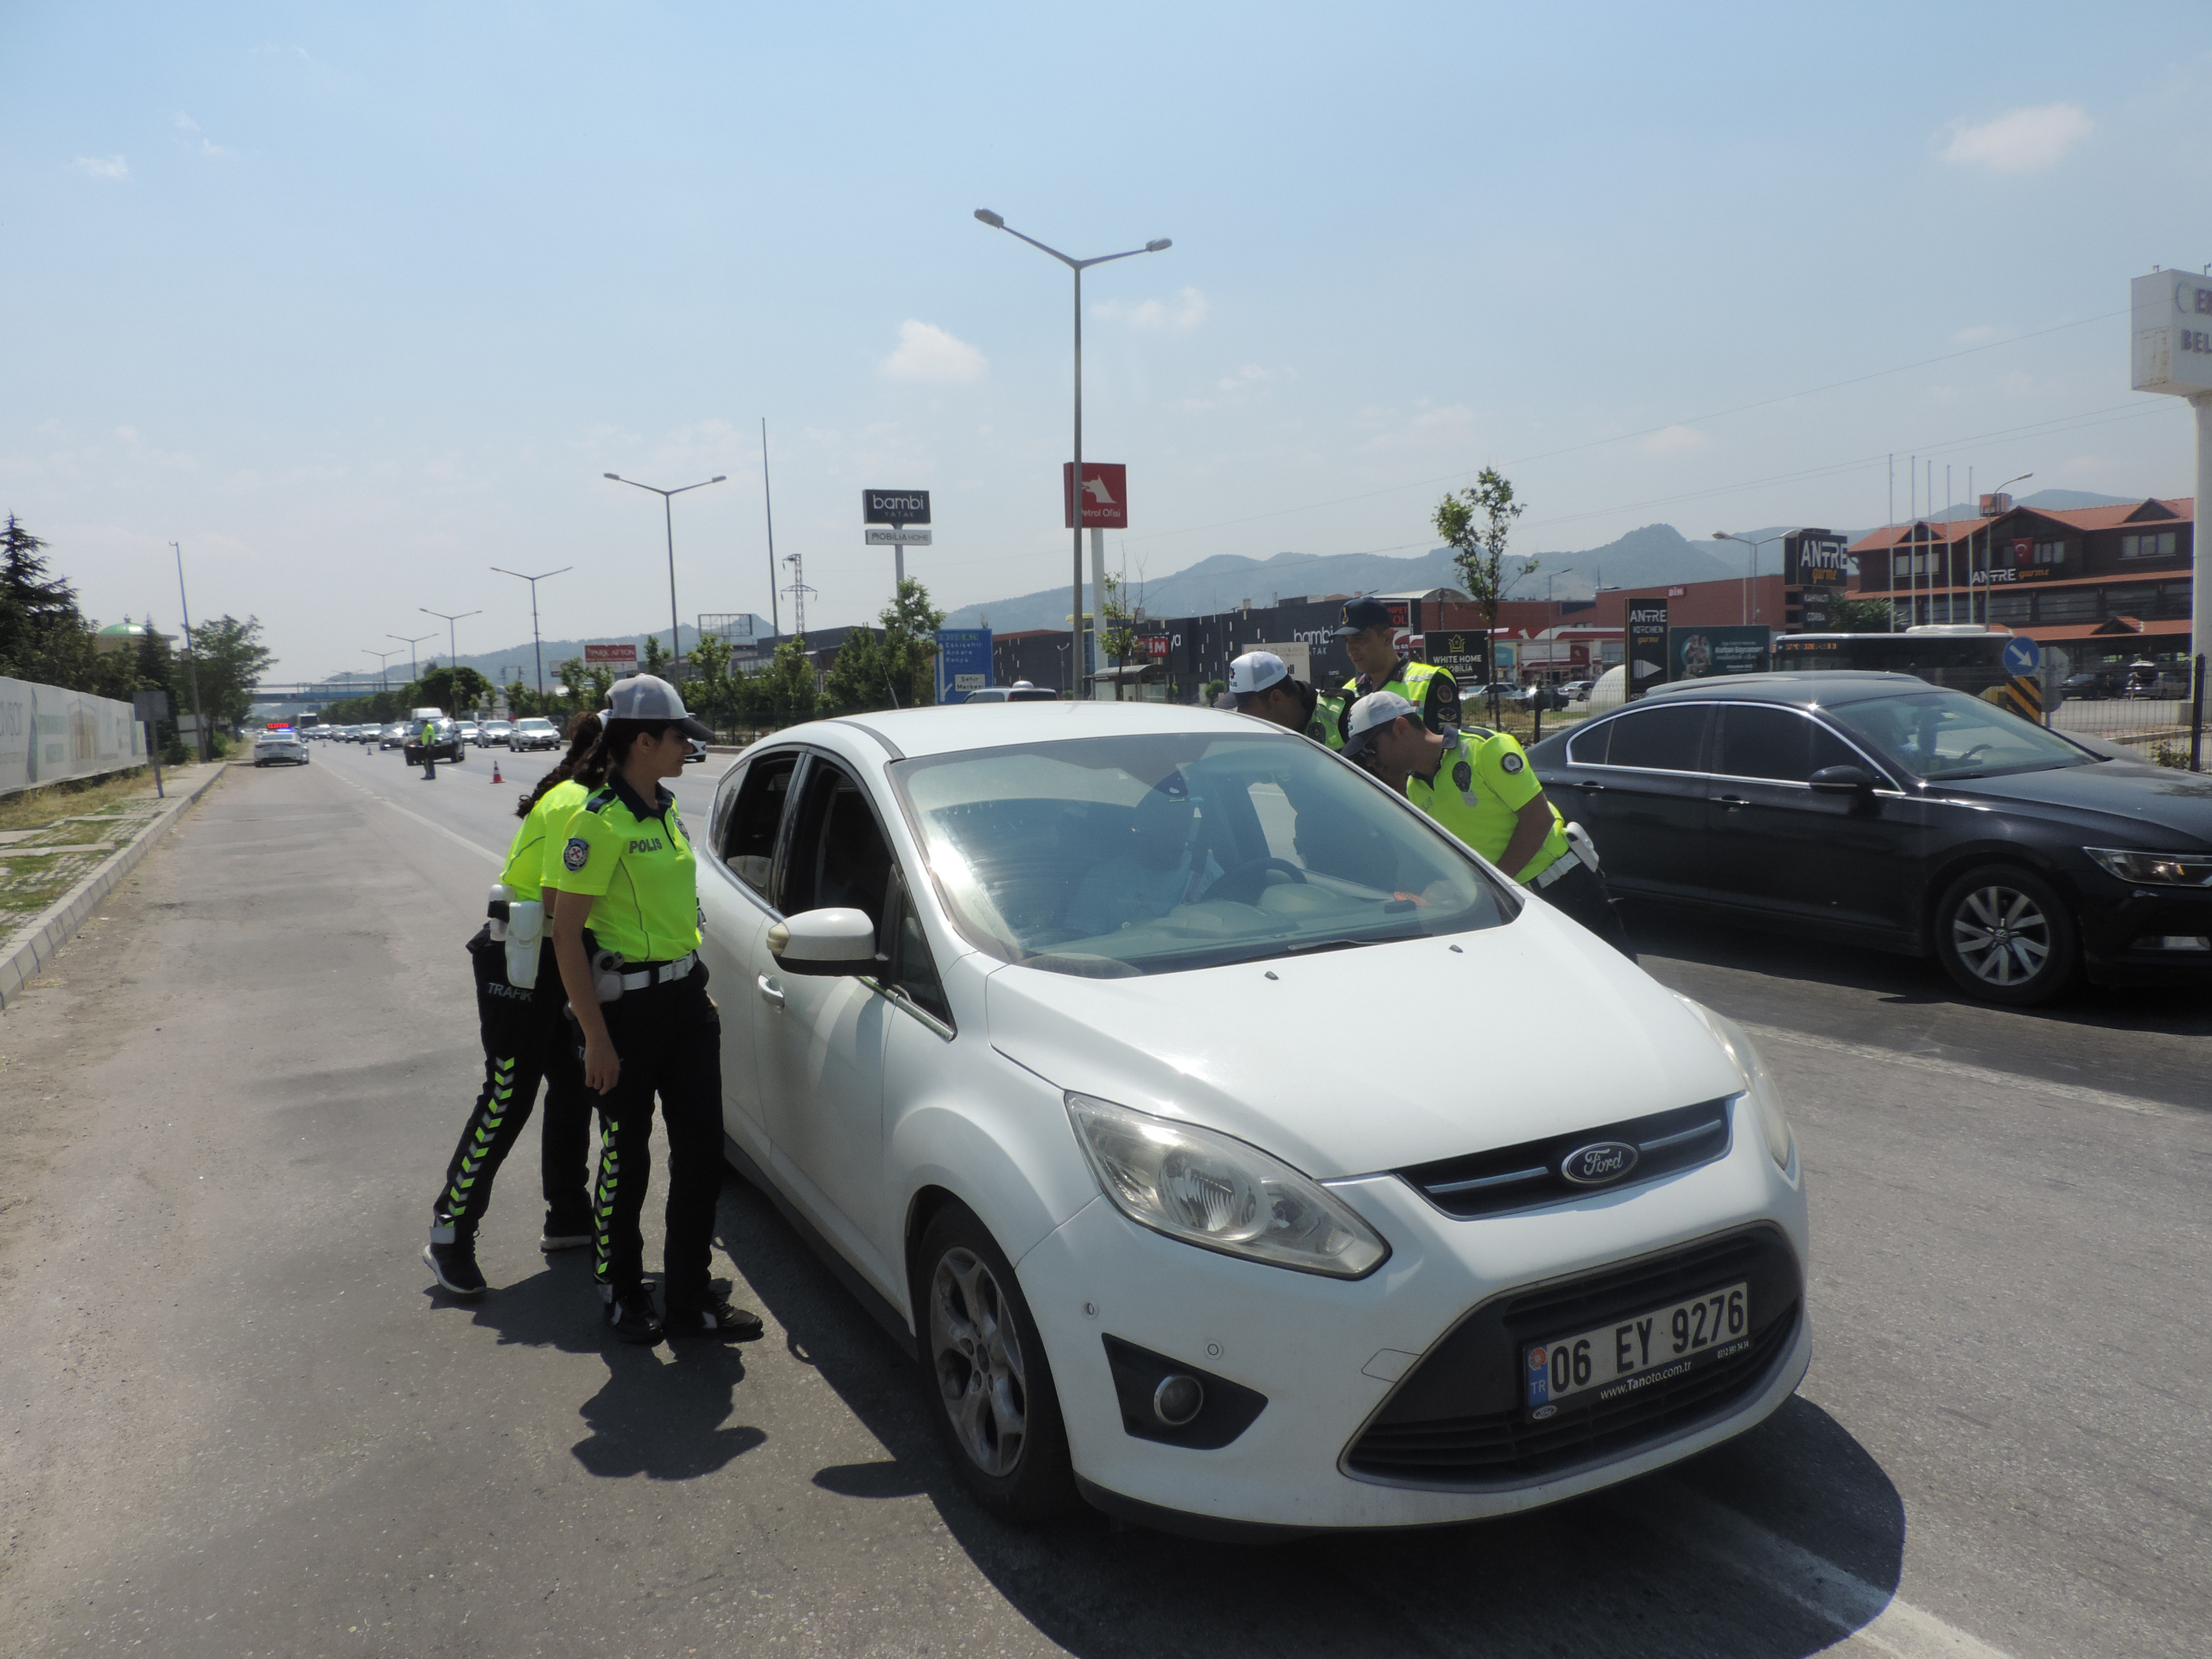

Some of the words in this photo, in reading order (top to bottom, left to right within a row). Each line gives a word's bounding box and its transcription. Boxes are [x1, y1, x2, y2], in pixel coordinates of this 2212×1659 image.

[873, 494, 924, 510] bambi
[1103, 508, 1121, 518] Ofisi
[1800, 539, 1848, 569] ANTRE
[1972, 568, 2017, 584] ANTRE
[2018, 569, 2050, 580] gurme
[1630, 609, 1668, 622] ANTRE
[1433, 655, 1458, 664] WHITE
[1459, 654, 1482, 663] HOME
[1583, 1147, 1624, 1176] Ford
[1551, 1339, 1592, 1394] 06
[1615, 1317, 1653, 1375] EY
[1672, 1290, 1745, 1354] 9276
[1530, 1379, 1547, 1395] TR
[1600, 1360, 1693, 1402] www.Tanoto.com.tr
